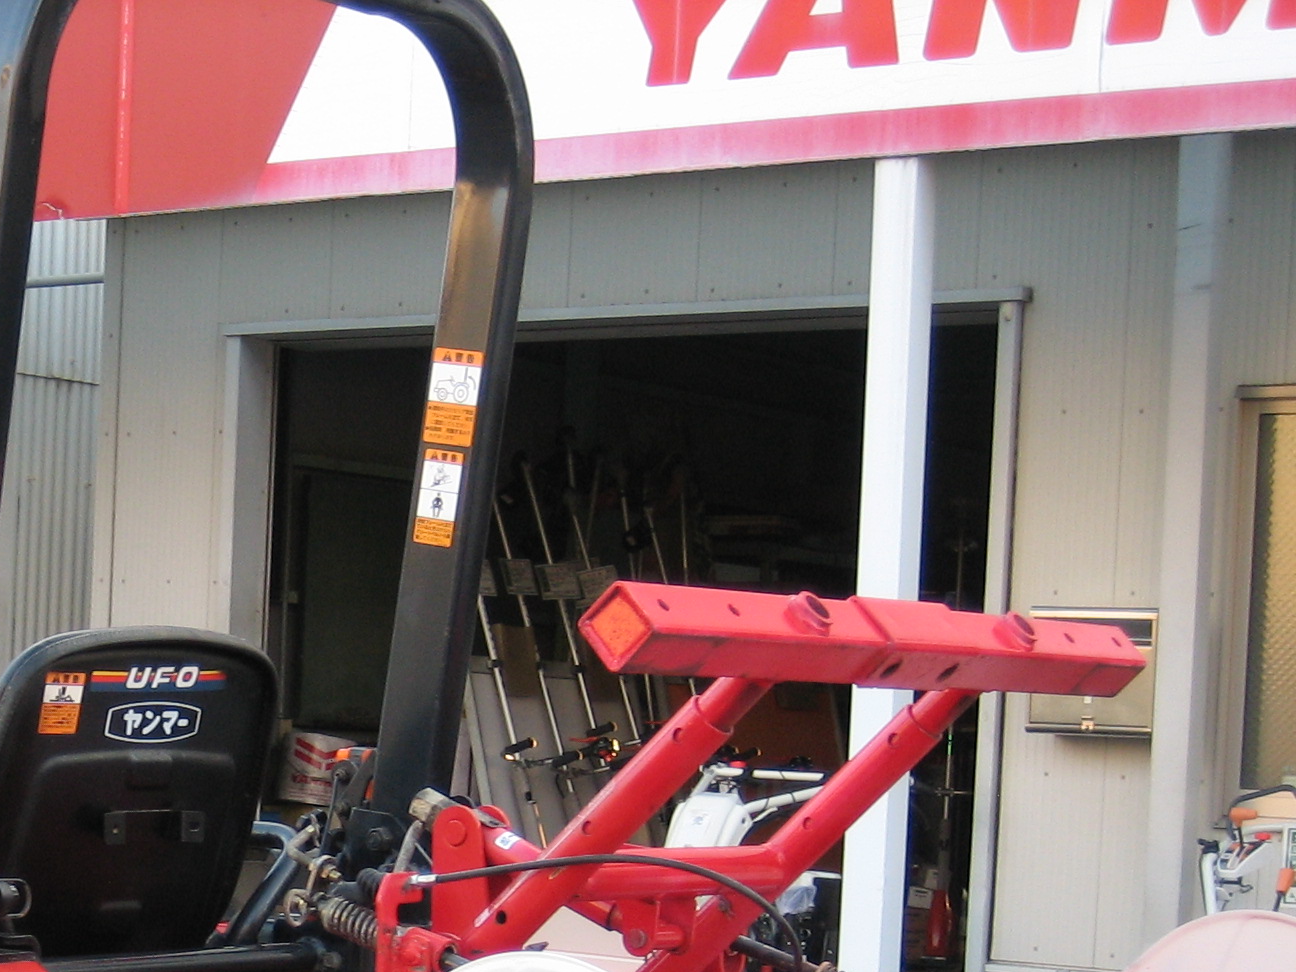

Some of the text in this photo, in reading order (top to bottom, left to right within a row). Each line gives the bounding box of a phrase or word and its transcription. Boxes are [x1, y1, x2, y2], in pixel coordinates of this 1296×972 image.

[125, 666, 200, 690] UFO
[122, 709, 190, 736] ヤンマー
